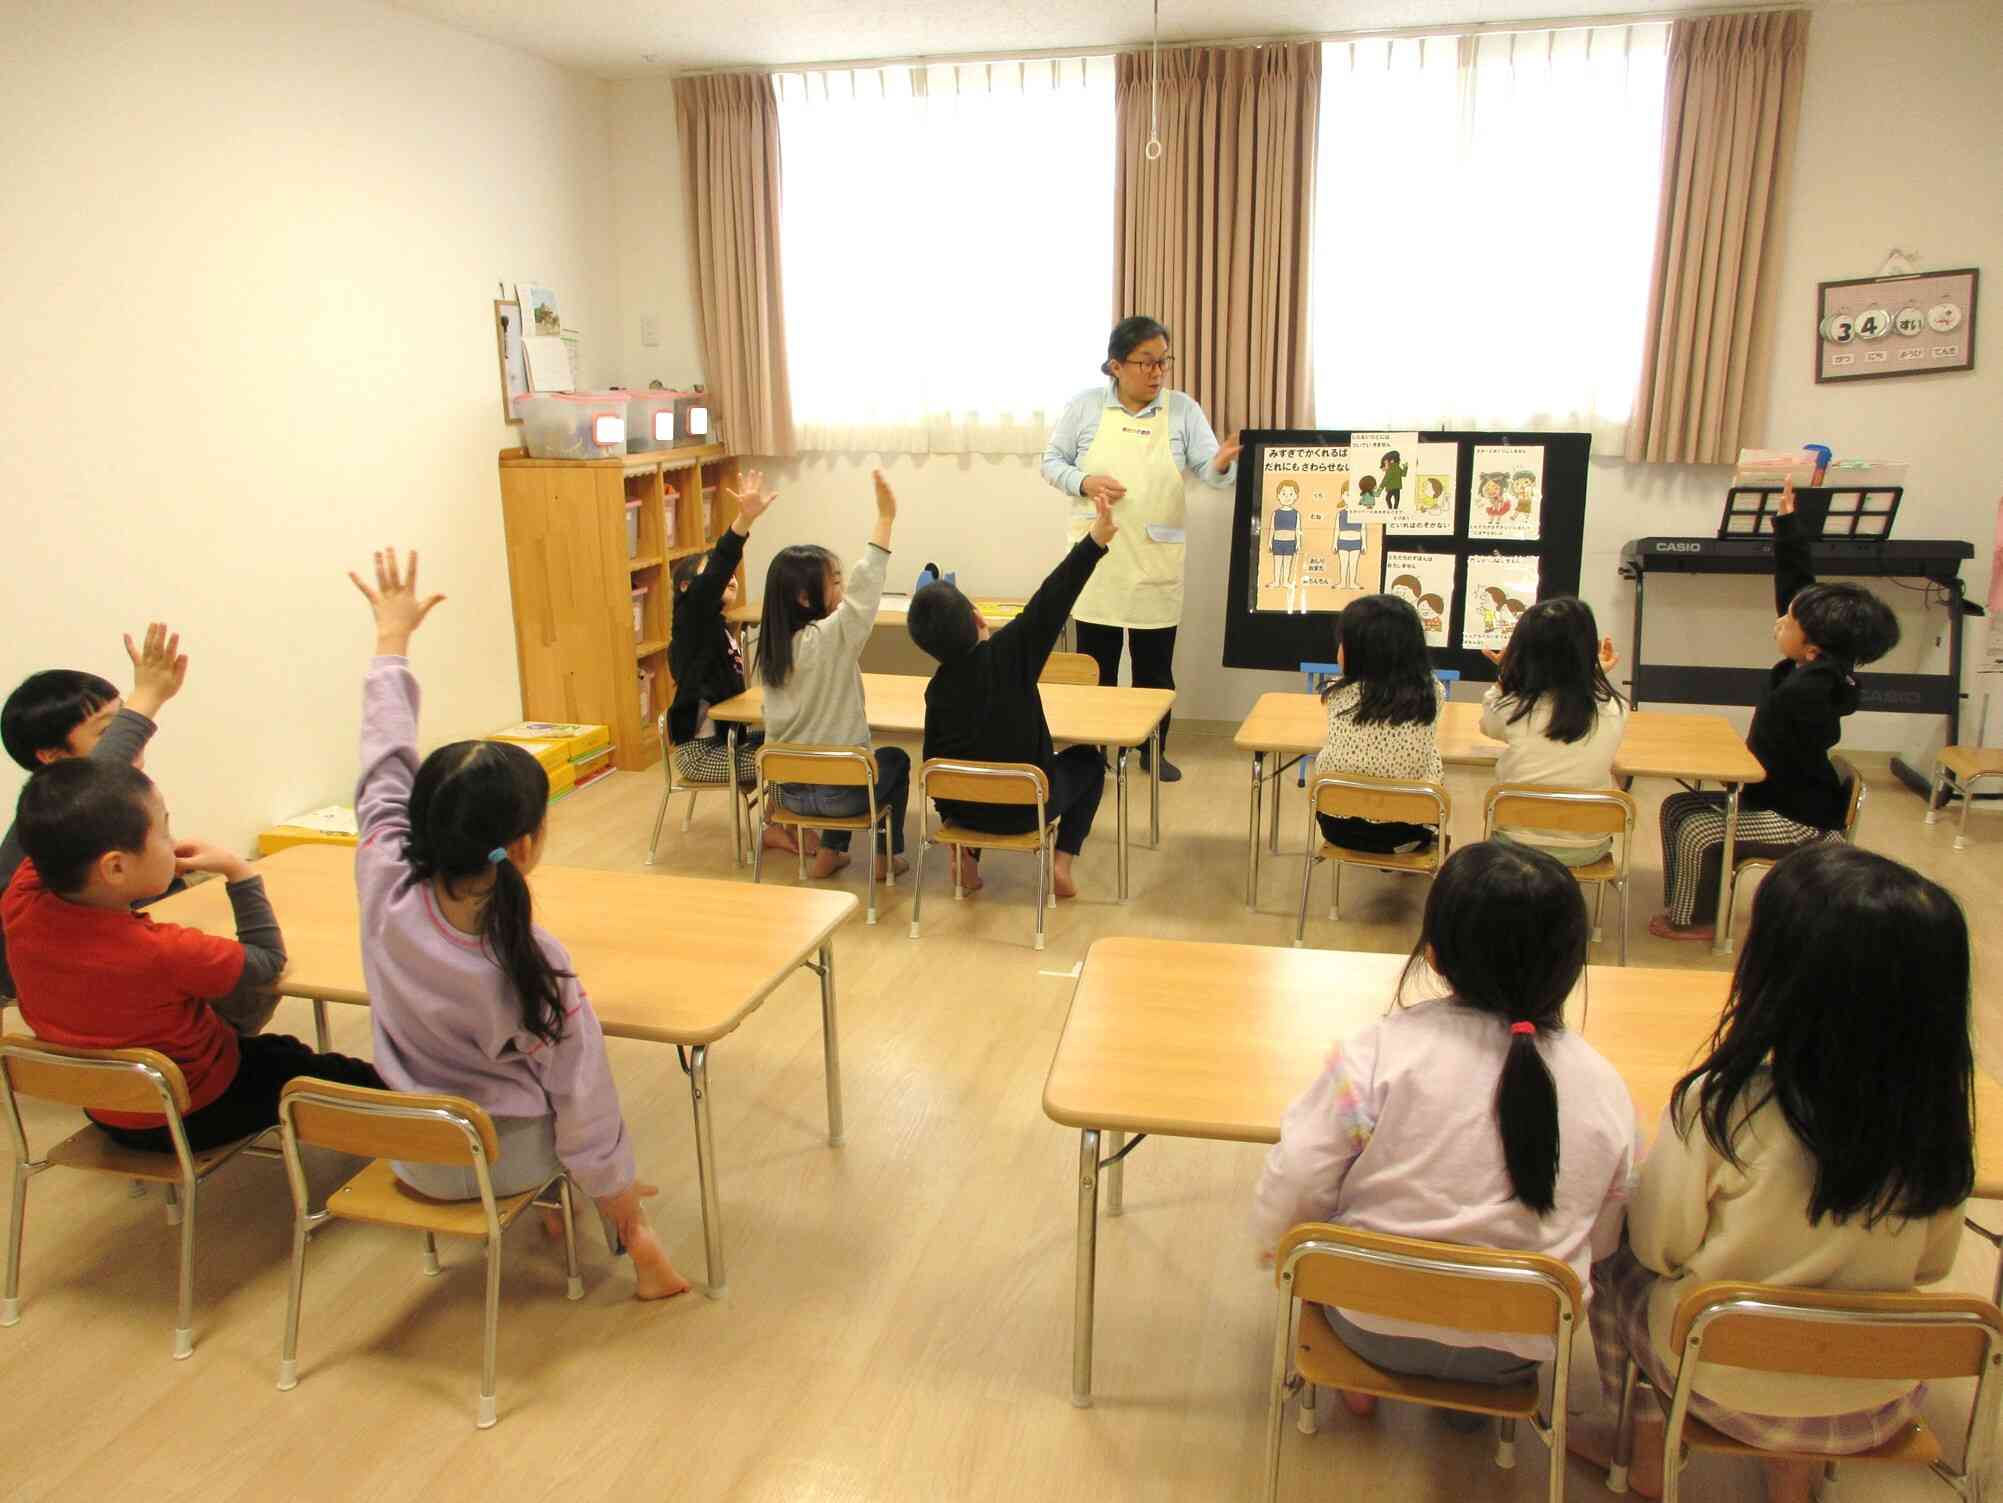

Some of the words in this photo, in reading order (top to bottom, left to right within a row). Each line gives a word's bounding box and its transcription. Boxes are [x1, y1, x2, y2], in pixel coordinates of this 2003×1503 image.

[1838, 323, 1852, 341] 3
[1861, 316, 1878, 335] 4
[1656, 542, 1701, 552] CASIO
